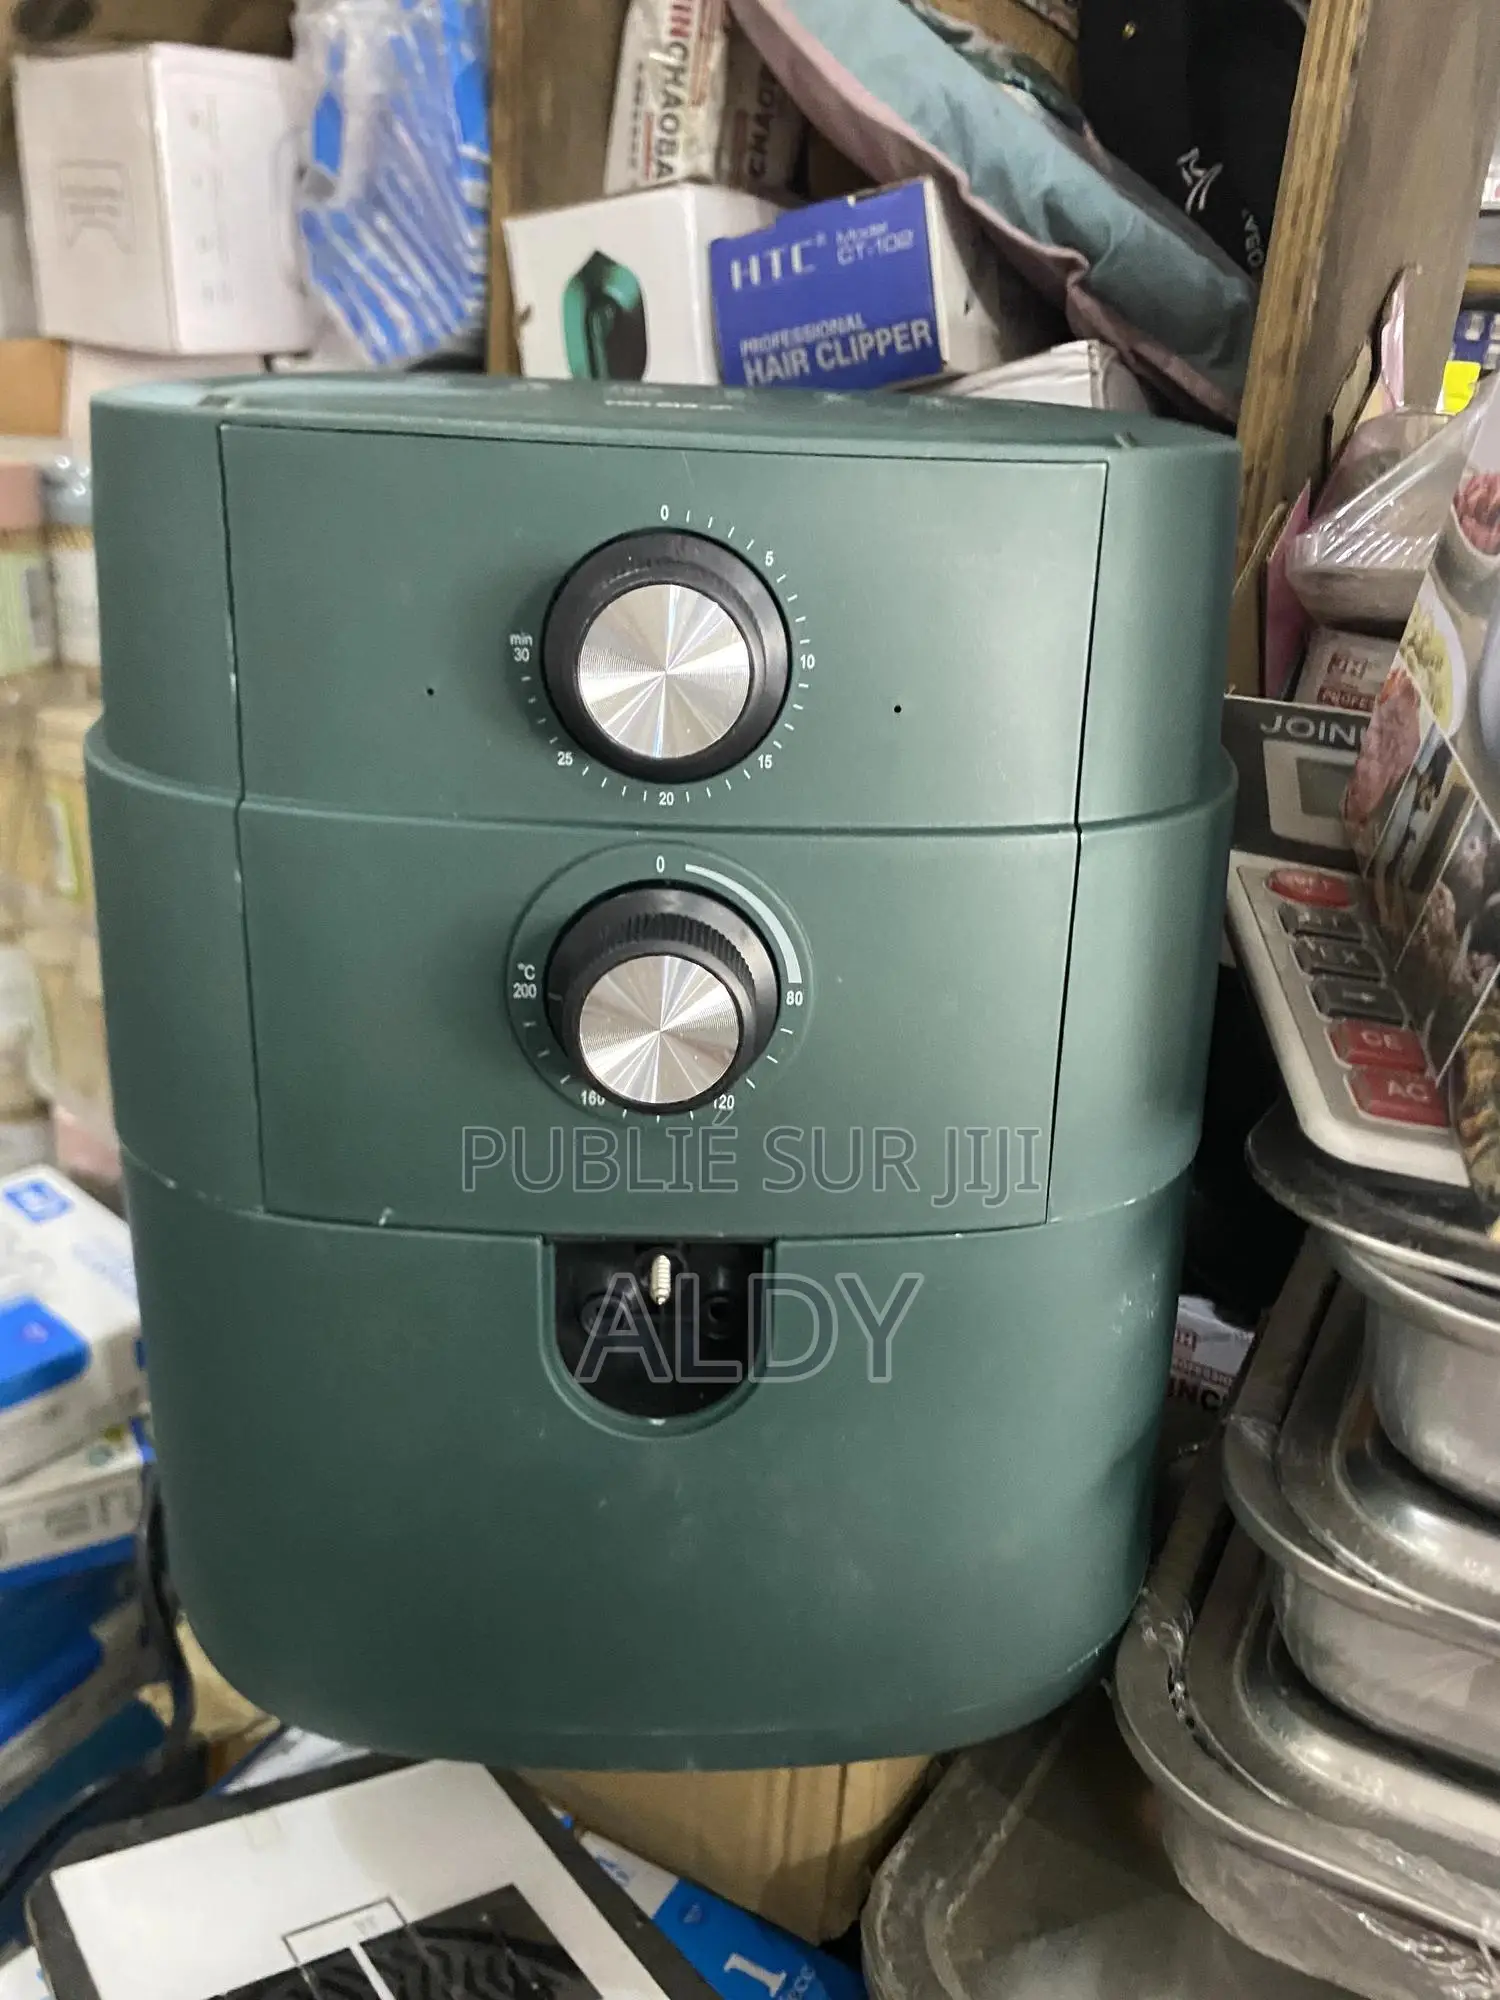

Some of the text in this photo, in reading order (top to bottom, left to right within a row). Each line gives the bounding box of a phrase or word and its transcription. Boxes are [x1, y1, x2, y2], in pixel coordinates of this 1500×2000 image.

[740, 312, 867, 357] PROFESSIONAL
[743, 318, 933, 387] HAIR CLIPPER
[660, 504, 670, 521] 0
[764, 550, 774, 567] 5
[509, 633, 533, 648] min
[513, 647, 530, 663] 30
[800, 654, 816, 670] 10
[1260, 714, 1369, 746] JOIN
[557, 751, 573, 767] 25
[757, 753, 773, 770] 15
[658, 790, 675, 807] 20
[655, 855, 666, 873] 0
[512, 983, 538, 999] 200
[786, 991, 804, 1006] 80
